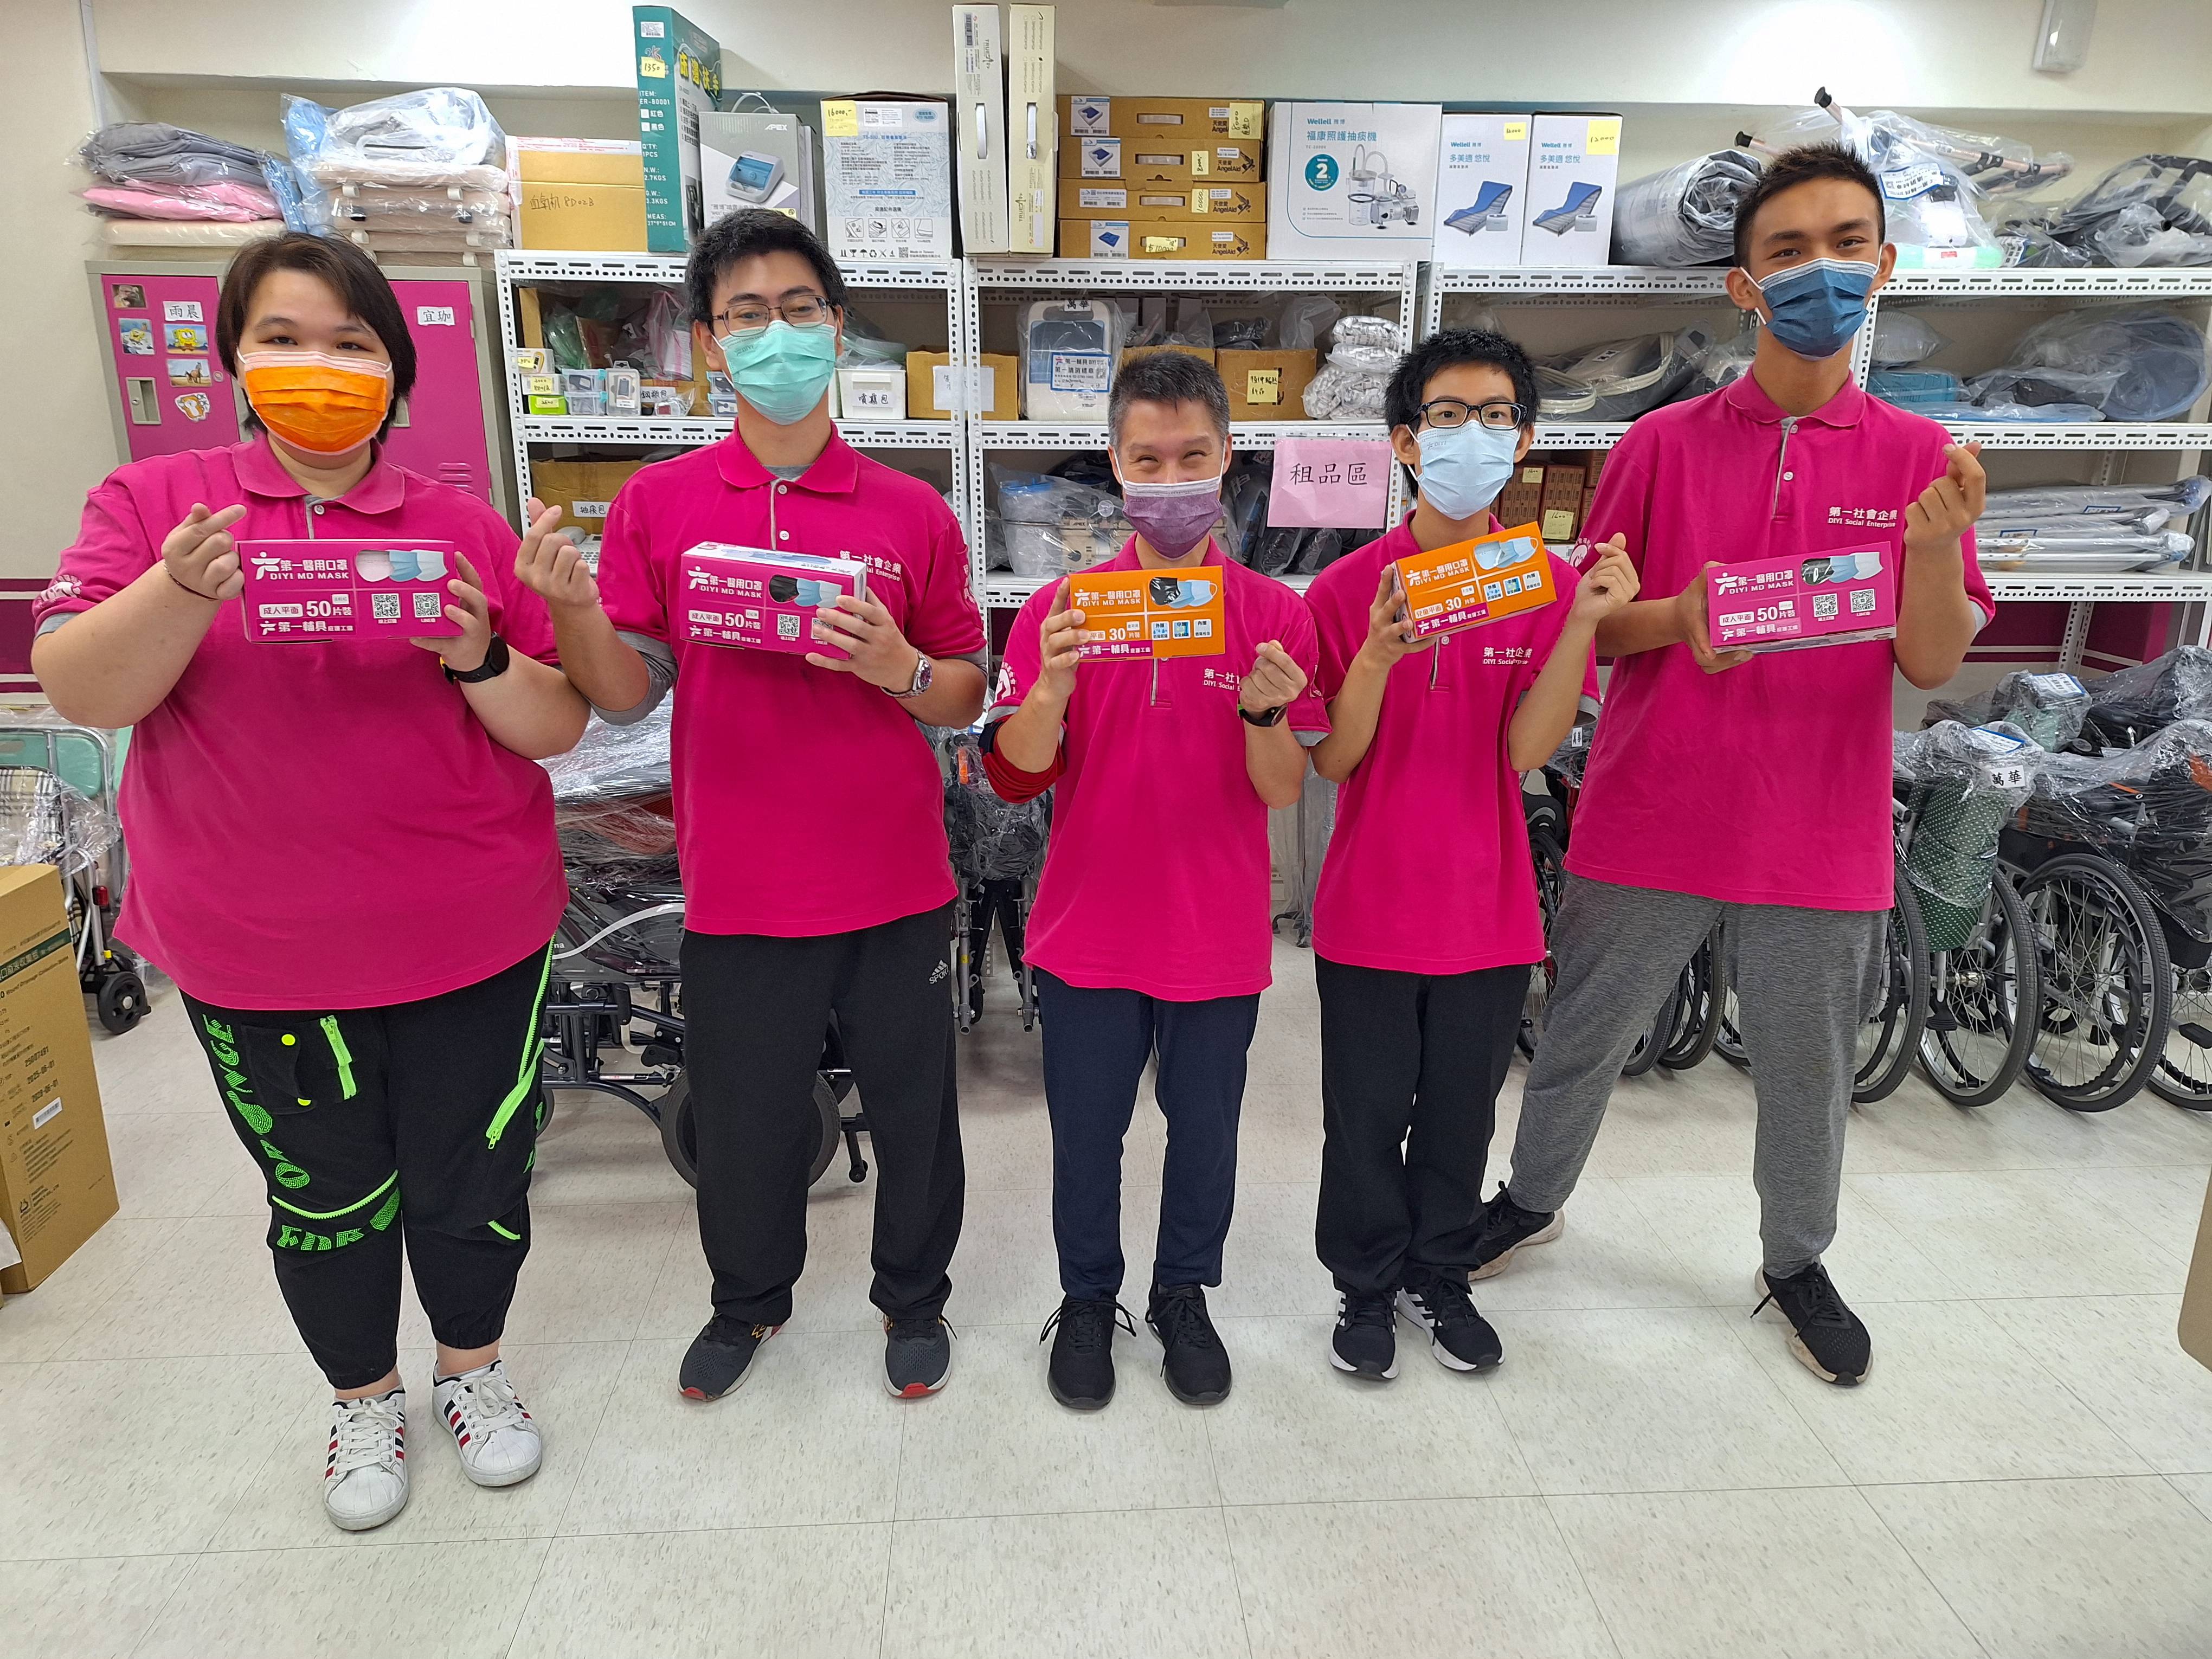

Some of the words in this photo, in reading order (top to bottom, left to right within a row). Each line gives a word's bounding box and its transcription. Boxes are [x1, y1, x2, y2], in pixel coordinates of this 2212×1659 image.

[644, 62, 660, 72] 1350
[1307, 131, 1377, 142] 福康照護抽痰機
[170, 305, 200, 318] 雨晨
[1289, 462, 1368, 486] 租品區
[1828, 506, 1898, 520] 第一社會企業
[280, 559, 348, 571] 第一醫用口罩
[839, 550, 902, 575] 第一社會企業
[1422, 558, 1469, 577] 第一醫用口罩
[876, 569, 901, 582] Enterprise
[1448, 568, 1470, 576] MASK
[1738, 570, 1793, 586] 第一醫用口罩
[710, 575, 763, 591] 第一醫用口罩
[1729, 586, 1748, 594] DIYI
[1768, 580, 1794, 589] MASK
[737, 590, 762, 599] MASK
[1090, 589, 1141, 600] 第一醫用口罩
[263, 606, 299, 615] 成人平面
[306, 600, 331, 617] 50
[332, 607, 352, 616] 片裝
[1416, 605, 1442, 617] 兒童平面
[1445, 596, 1462, 612] 30
[692, 613, 719, 622] 成人平面
[724, 612, 745, 628] 50
[1431, 612, 1466, 628] 第一輔具
[1722, 615, 1752, 623] 成人平面
[1757, 607, 1778, 621] 50
[1779, 609, 1796, 619] 片裝
[278, 621, 327, 632] 第一輔具
[1737, 623, 1776, 638] 第一輔具
[703, 627, 741, 641] 第一輔具
[1109, 627, 1126, 641] 30
[1092, 644, 1130, 655] 第一輔具
[1218, 681, 1234, 691] Social
[1991, 769, 2022, 786] 萬華
